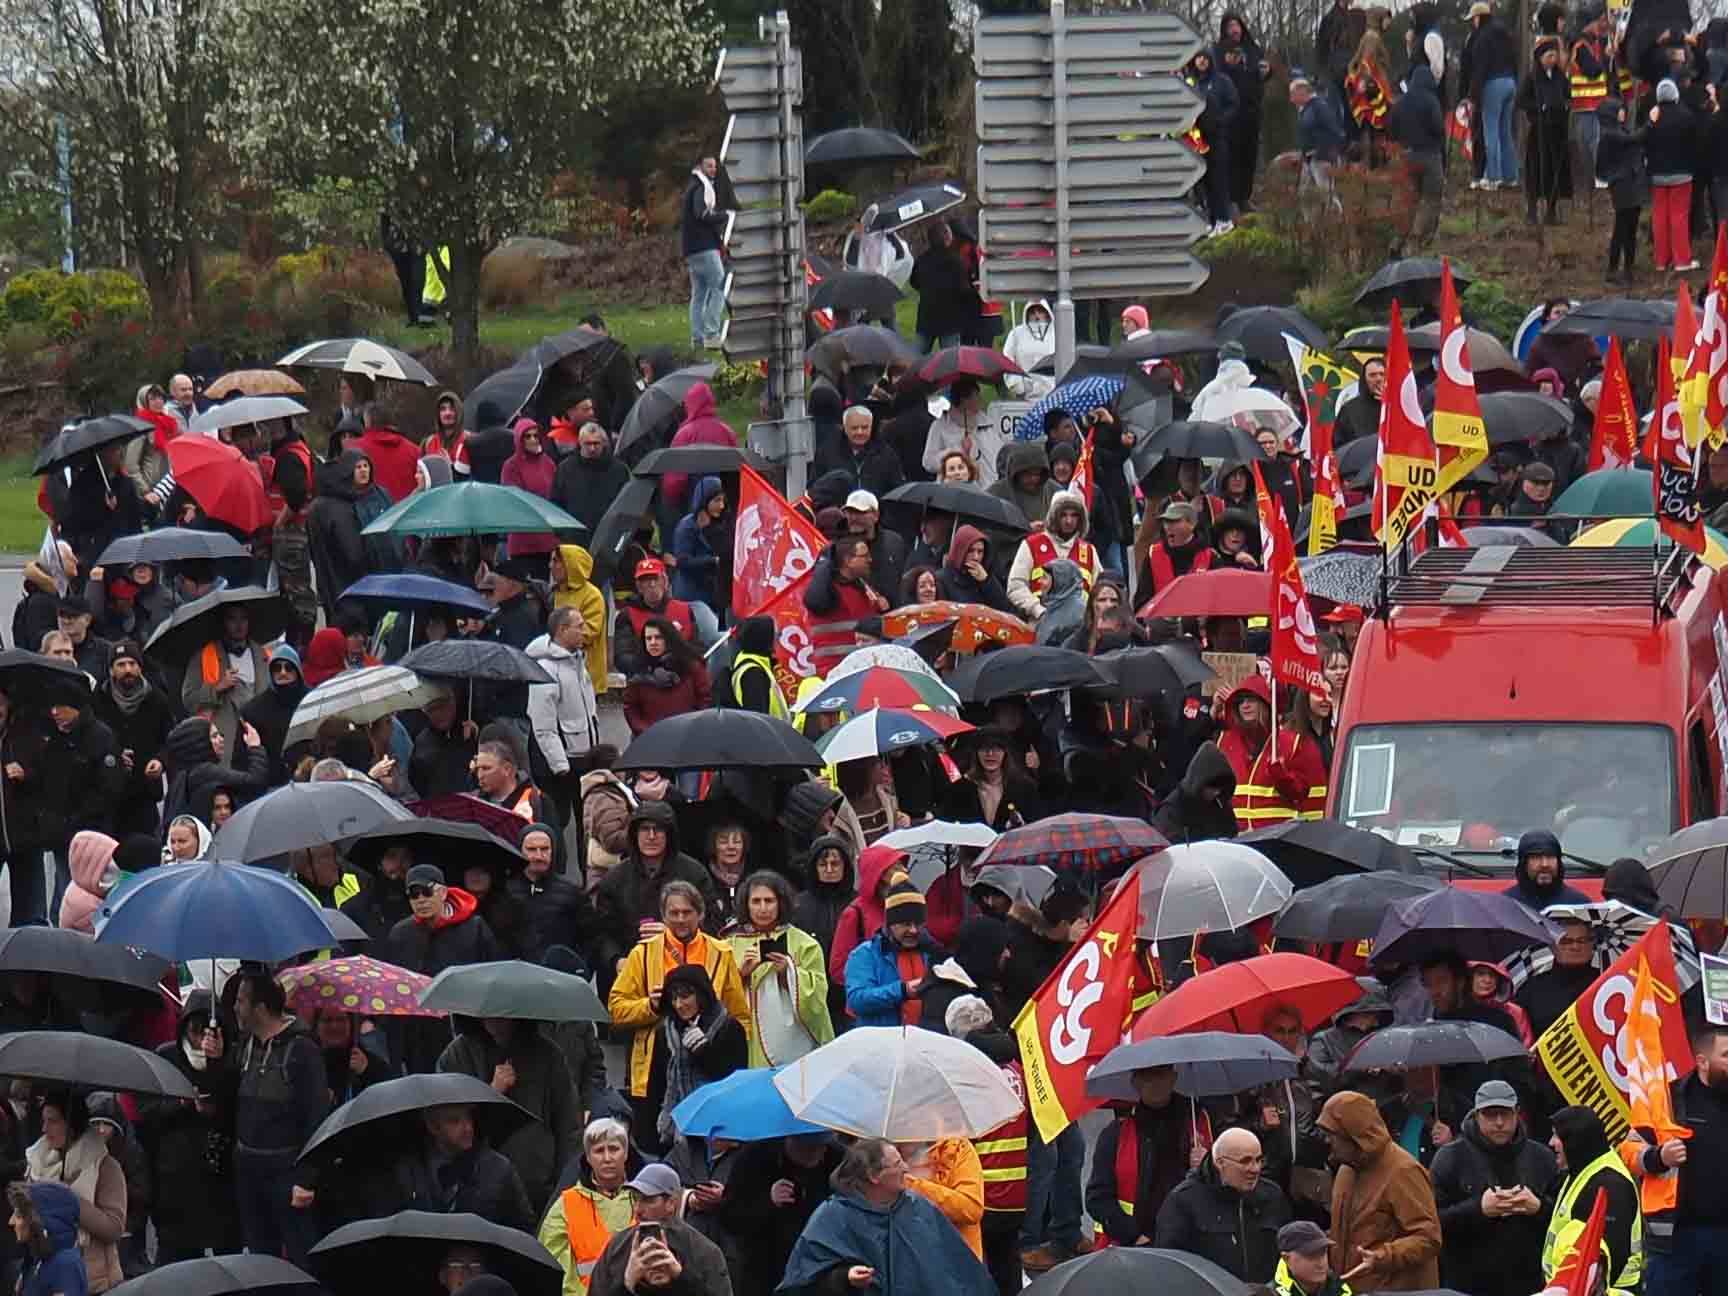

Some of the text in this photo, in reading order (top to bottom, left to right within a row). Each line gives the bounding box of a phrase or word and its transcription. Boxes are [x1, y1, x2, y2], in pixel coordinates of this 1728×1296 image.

[1462, 424, 1480, 437] UD
[1408, 464, 1437, 487] UD
[1544, 1012, 1632, 1150] PÉNITENTIAIR
